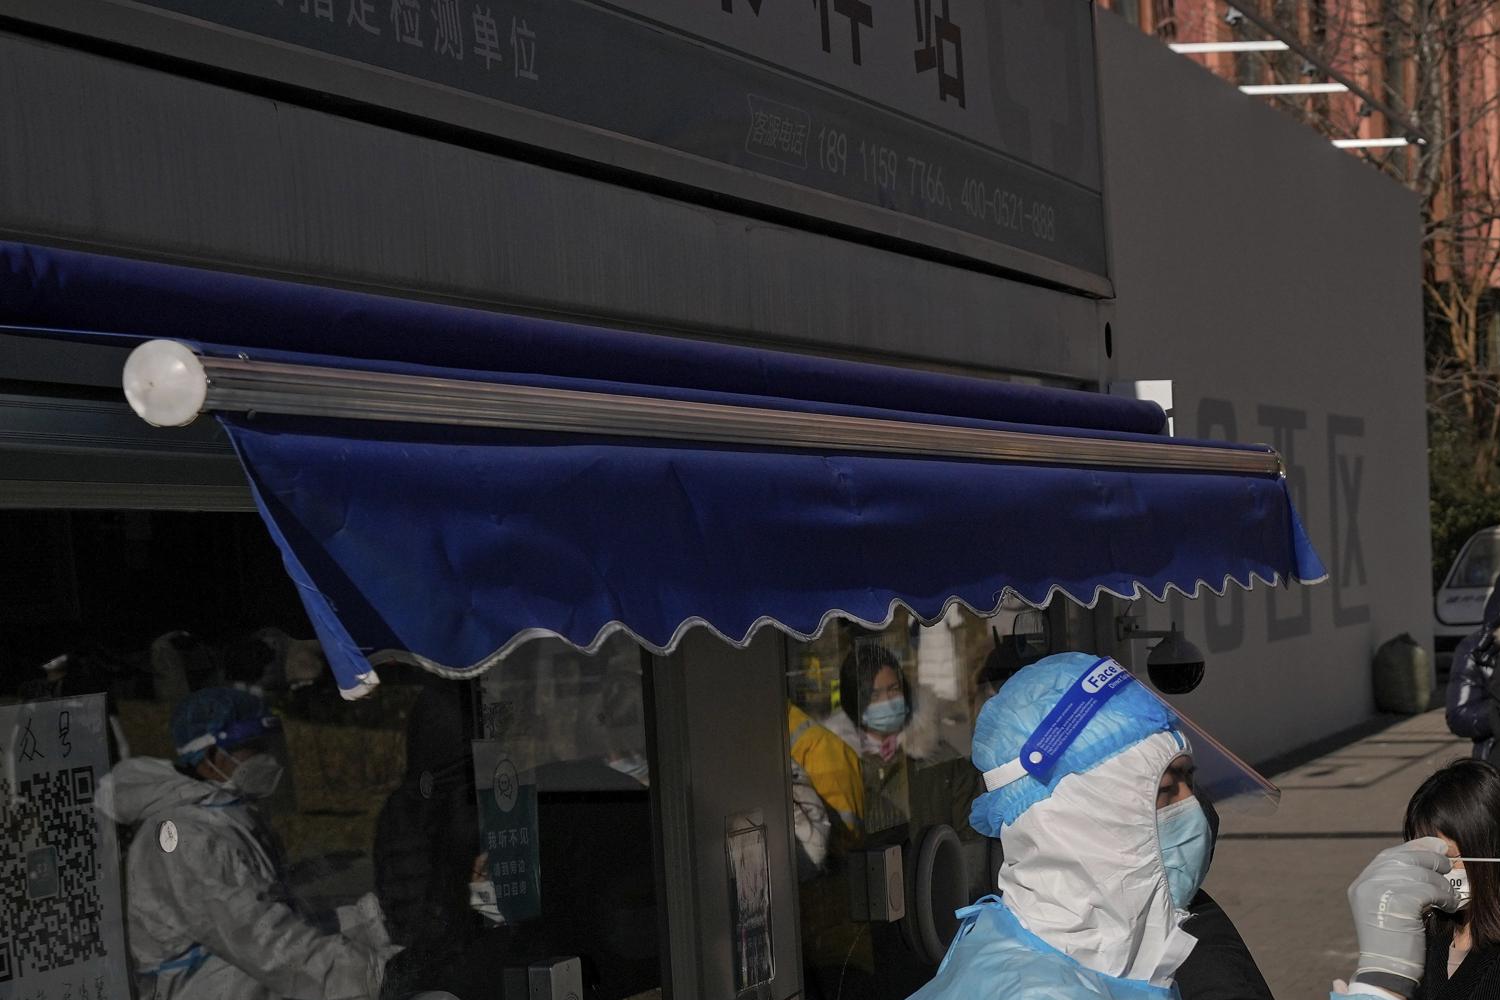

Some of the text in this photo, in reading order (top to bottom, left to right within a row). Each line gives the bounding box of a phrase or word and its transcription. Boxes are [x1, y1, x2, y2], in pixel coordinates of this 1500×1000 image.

[817, 126, 848, 177] 189
[858, 140, 898, 191] 1159
[1087, 665, 1117, 689] Face
[487, 827, 529, 850] 我听不见
